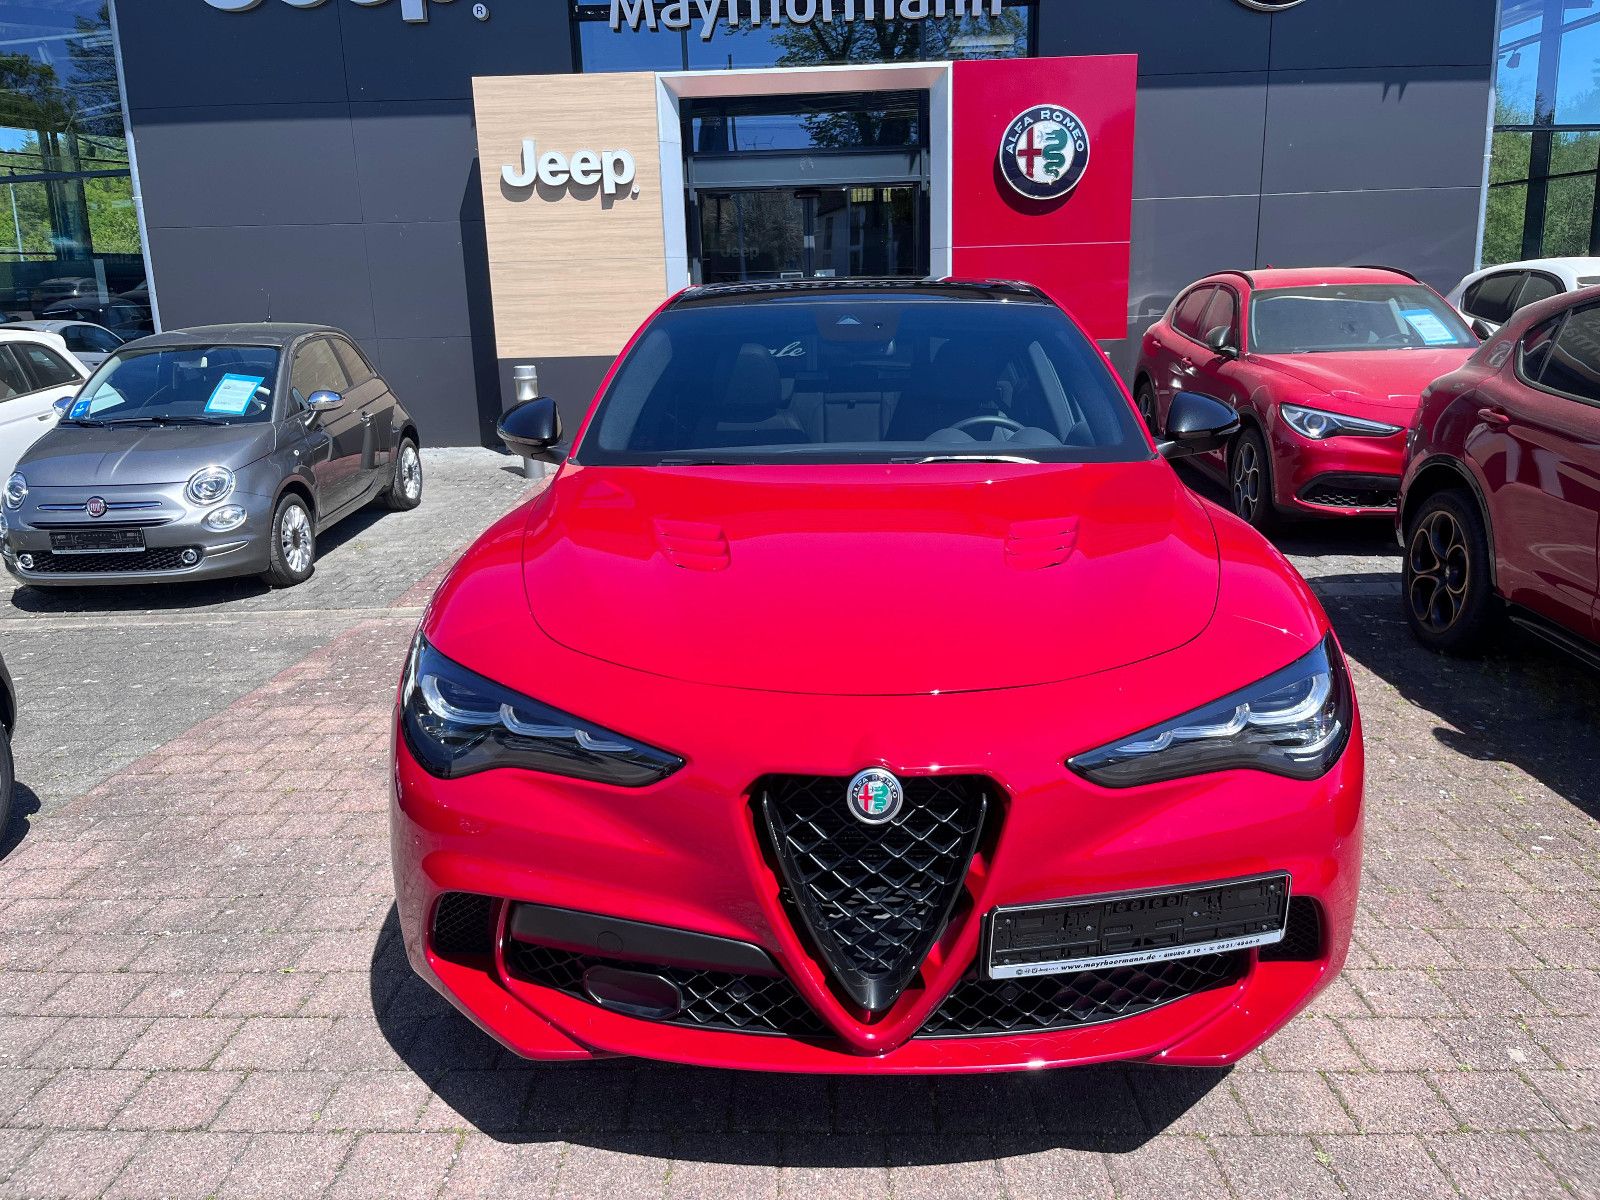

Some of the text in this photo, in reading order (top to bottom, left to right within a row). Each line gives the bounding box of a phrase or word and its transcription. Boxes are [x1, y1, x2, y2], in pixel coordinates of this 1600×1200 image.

[1005, 109, 1085, 155] ALFA ROMEO
[501, 138, 636, 195] Jeep
[852, 776, 869, 799] ALFA
